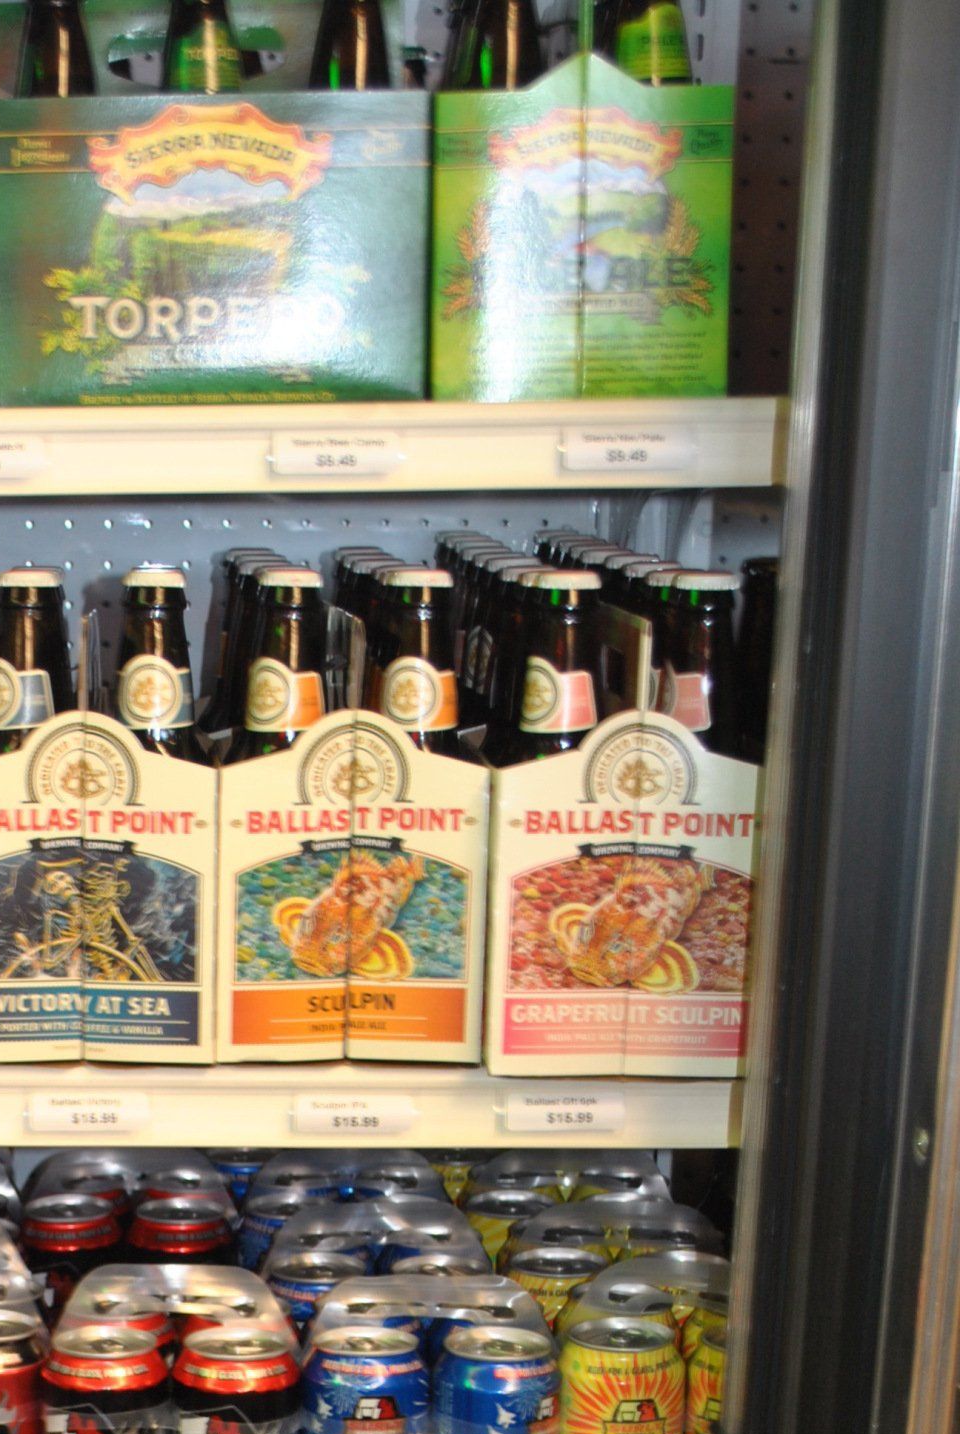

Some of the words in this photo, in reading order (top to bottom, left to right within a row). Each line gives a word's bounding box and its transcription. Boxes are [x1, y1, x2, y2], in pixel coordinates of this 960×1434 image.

[126, 136, 205, 169] SIERRA
[209, 131, 296, 165] NEVADA
[68, 294, 344, 343] TORPEO
[111, 810, 194, 835] POINT
[246, 807, 372, 834] BALLAST
[378, 806, 464, 832] POINT
[523, 809, 654, 837] BALLAST
[662, 812, 753, 838] POINT
[636, 846, 681, 858] COMPANY
[95, 995, 123, 1016] AT
[127, 996, 171, 1017] SEA
[306, 993, 396, 1014] SCULPIN
[509, 1002, 652, 1026] GRAPEFRUIT
[654, 1003, 743, 1026] SCULPIN
[525, 1096, 560, 1106] Ballast
[546, 1112, 594, 1125] $15.99
